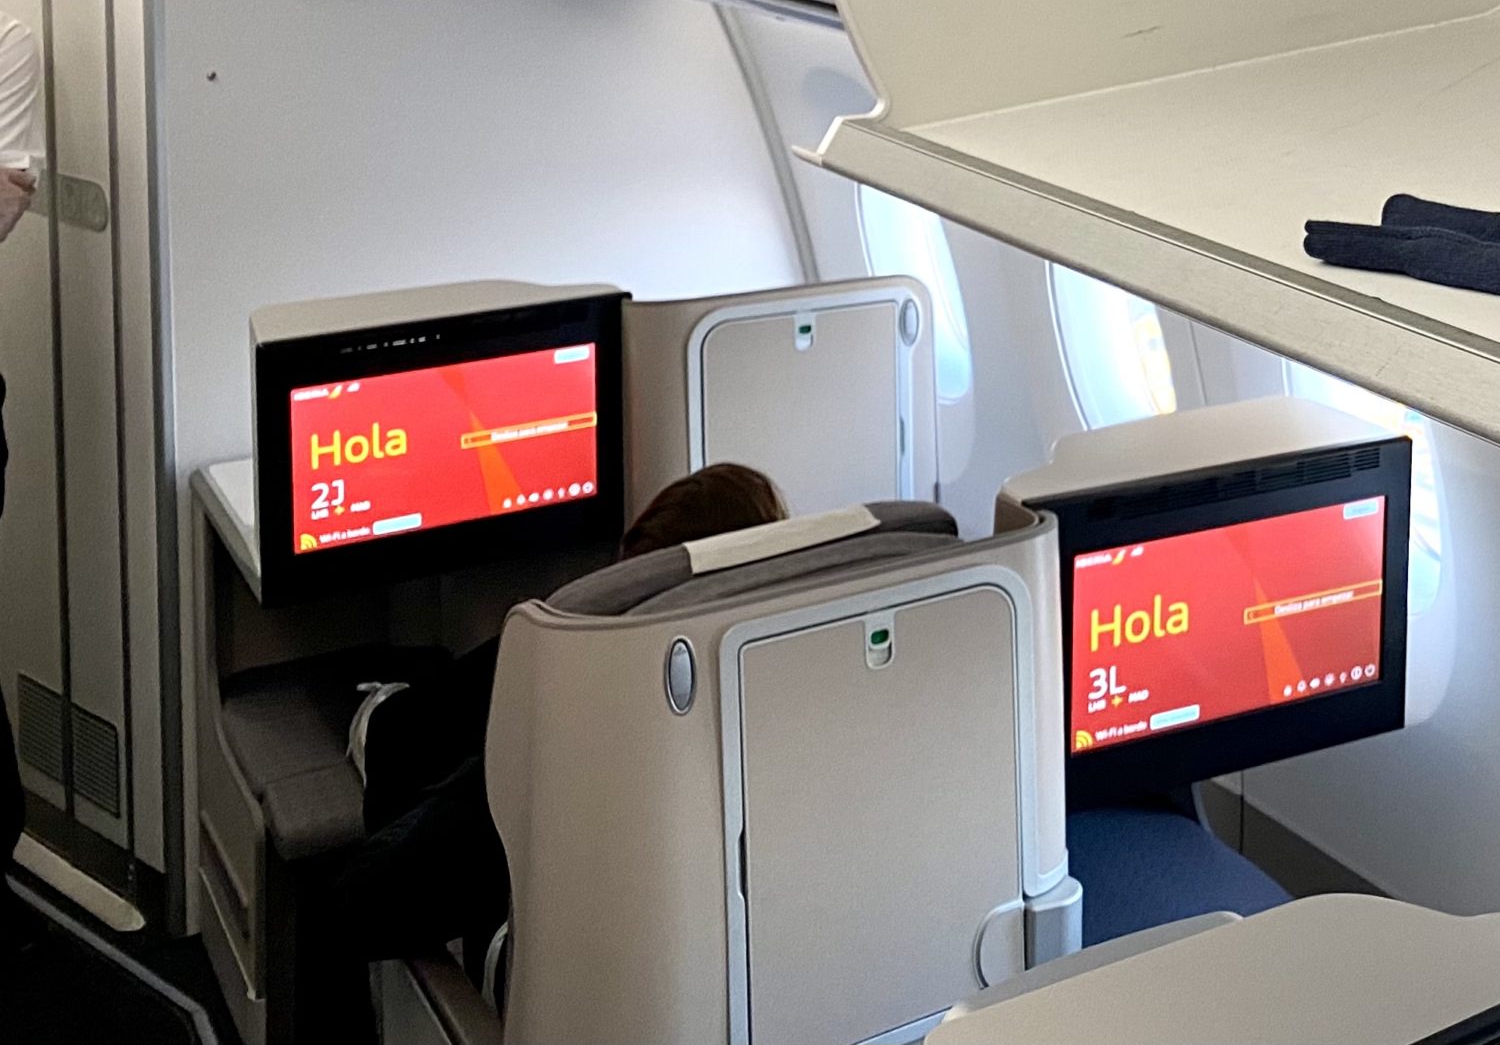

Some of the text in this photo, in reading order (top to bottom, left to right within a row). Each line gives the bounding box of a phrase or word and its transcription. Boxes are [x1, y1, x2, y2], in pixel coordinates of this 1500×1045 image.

[310, 422, 408, 470] Hola
[311, 479, 345, 509] 2J
[1090, 594, 1190, 652] Hola
[1088, 665, 1127, 700] 3L
